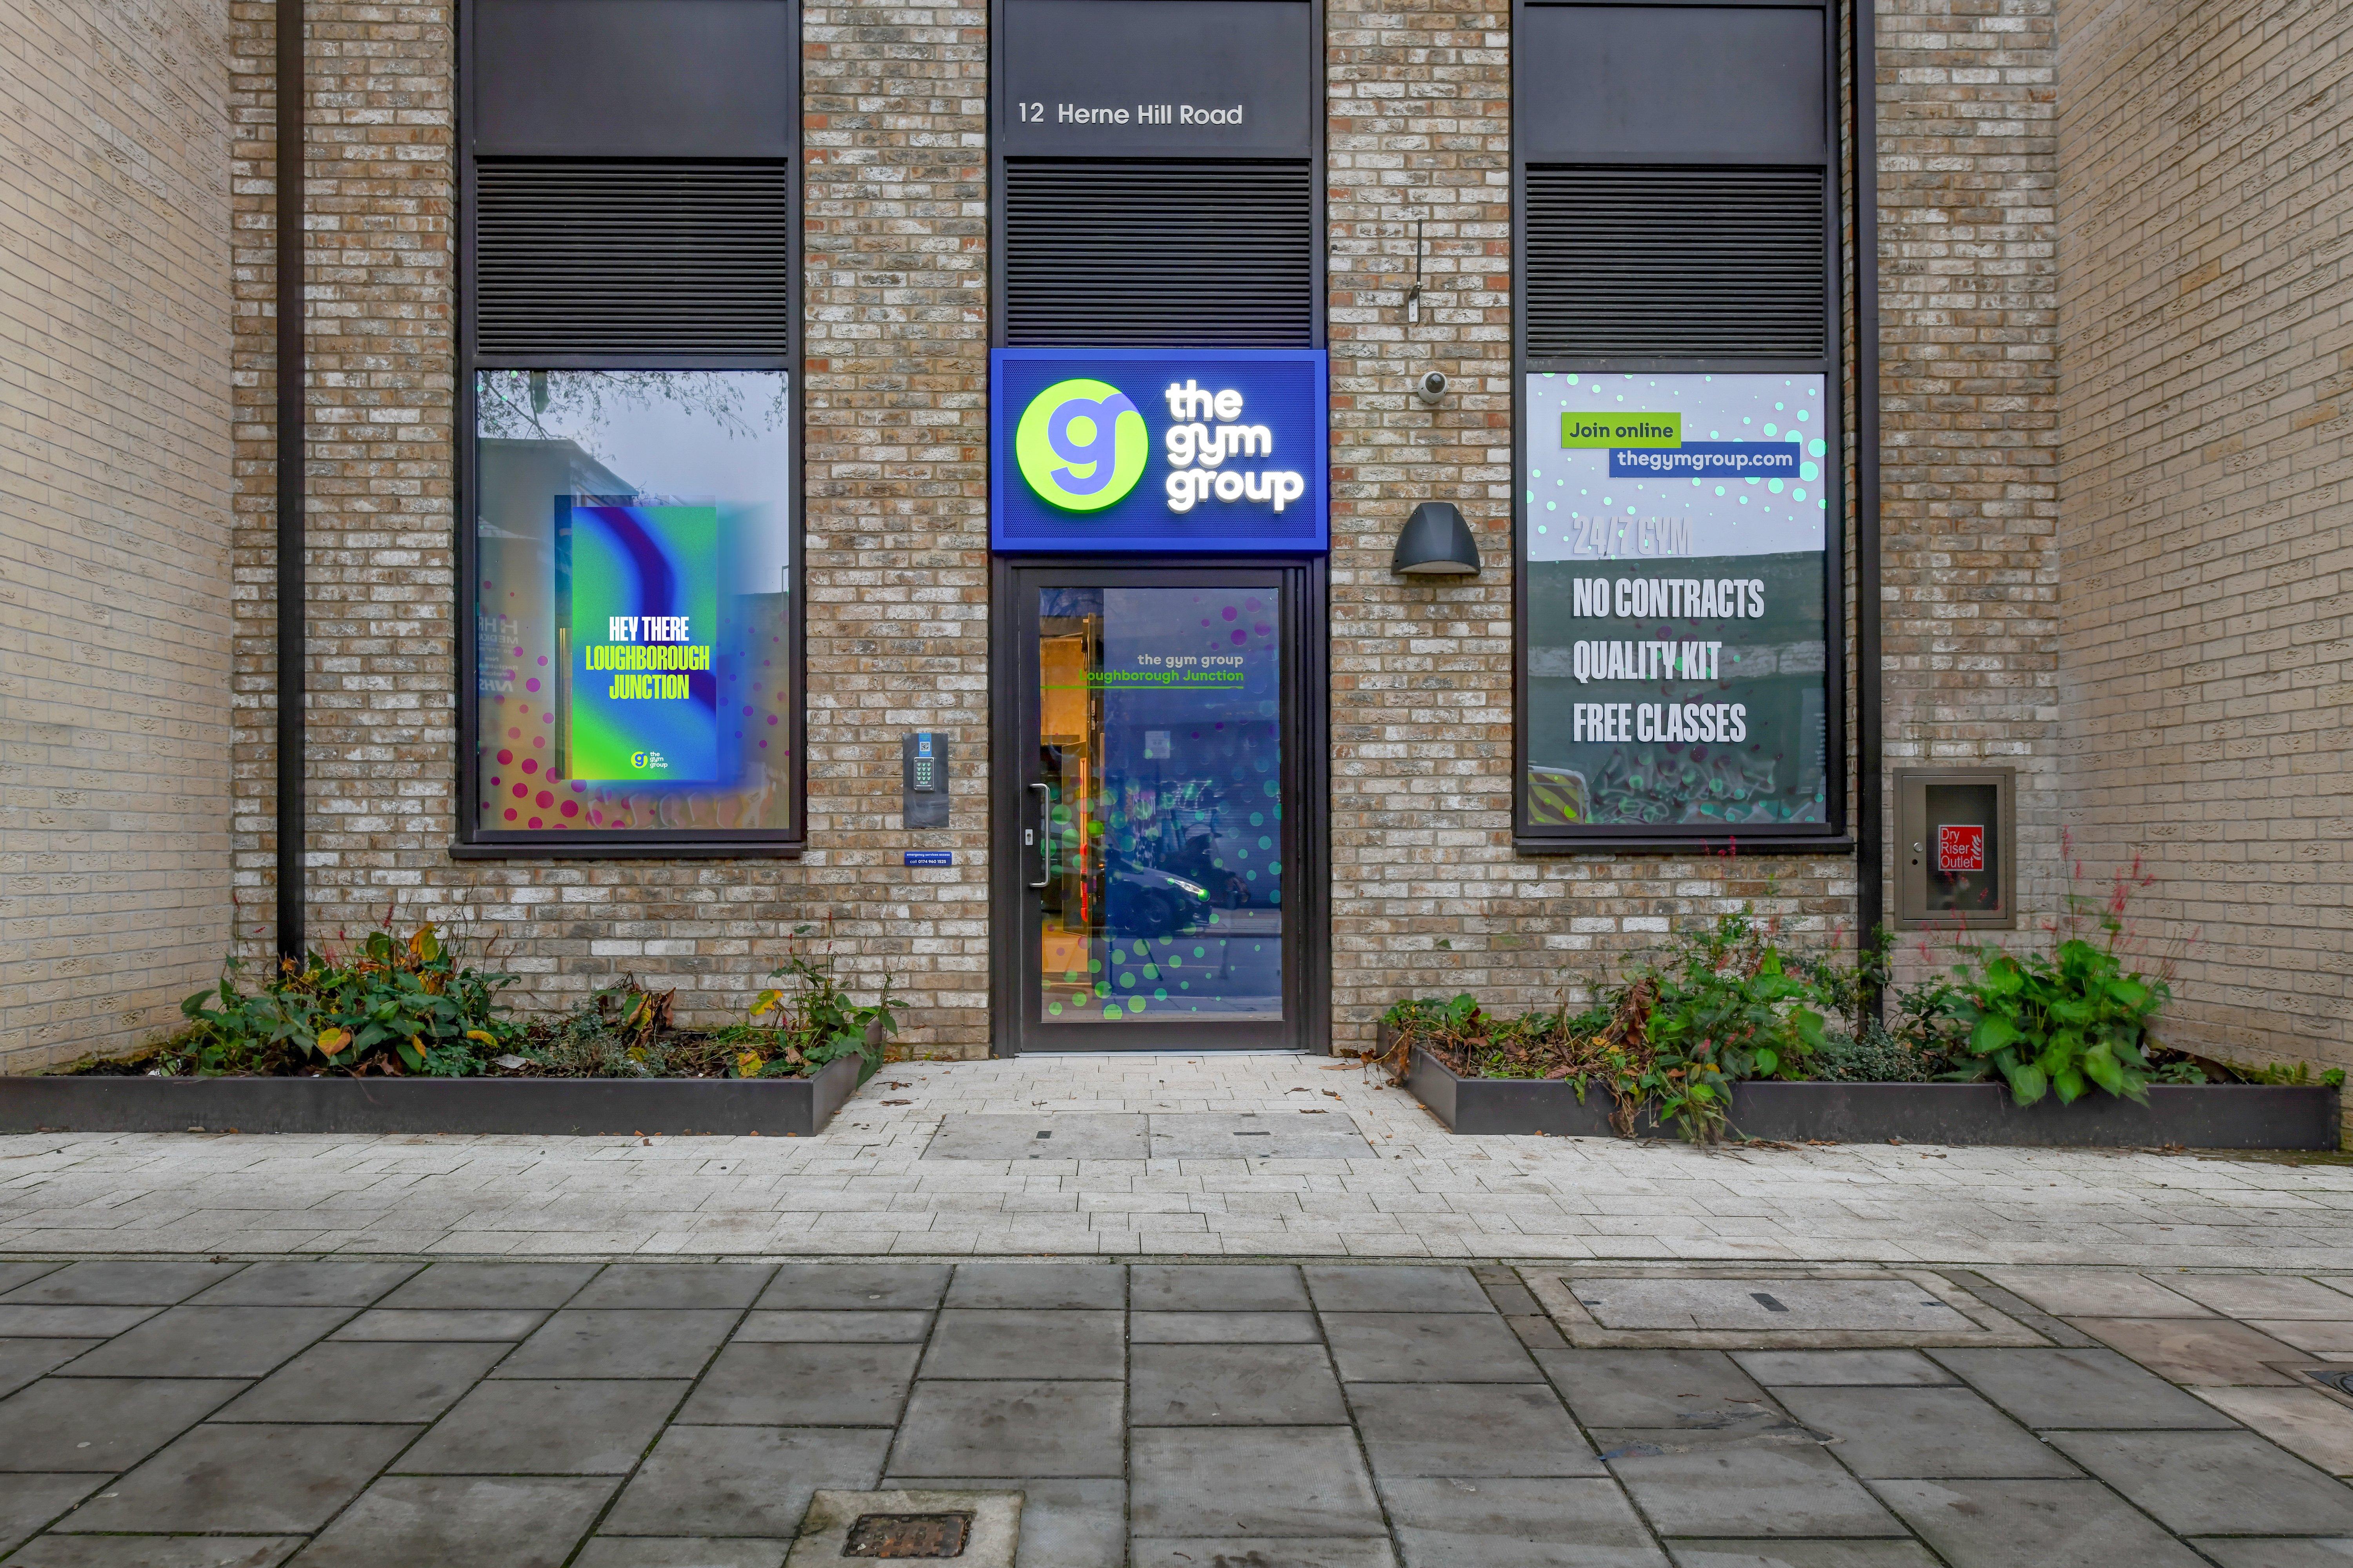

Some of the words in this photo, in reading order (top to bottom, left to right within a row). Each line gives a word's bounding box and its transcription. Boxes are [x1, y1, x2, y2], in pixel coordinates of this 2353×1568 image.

[1018, 102, 1044, 123] 12
[1059, 104, 1129, 124] Herne
[1138, 104, 1171, 124] Hill
[1180, 105, 1242, 125] Road
[1166, 380, 1243, 422] the
[1569, 422, 1610, 438] Join
[1615, 422, 1673, 438] online
[1166, 423, 1271, 469] gym
[1617, 451, 1793, 471] thegymgroup.com
[1166, 469, 1304, 514] group
[1573, 516, 1632, 554] 24/7
[1638, 516, 1693, 555] GYM
[1573, 578, 1610, 618] NO
[1615, 578, 1764, 618] CONTRACTS
[609, 616, 638, 641] HEY
[642, 616, 689, 641] THERE
[586, 645, 709, 670] LOUGHBOROUGH
[1137, 654, 1161, 665] the
[1166, 655, 1197, 668] gym
[1201, 655, 1244, 668] group
[1573, 640, 1677, 683] QUALITY
[1682, 641, 1722, 680] KIT
[609, 674, 689, 700] JUNCTION
[1079, 670, 1179, 684] Loughborough
[1183, 670, 1244, 681] Junction
[1573, 703, 1632, 742] FREE
[1637, 703, 1746, 743] CLASSES
[1941, 828, 1959, 843] Dry
[1941, 842, 1970, 854] Riser
[1941, 856, 1974, 868] Outlet
